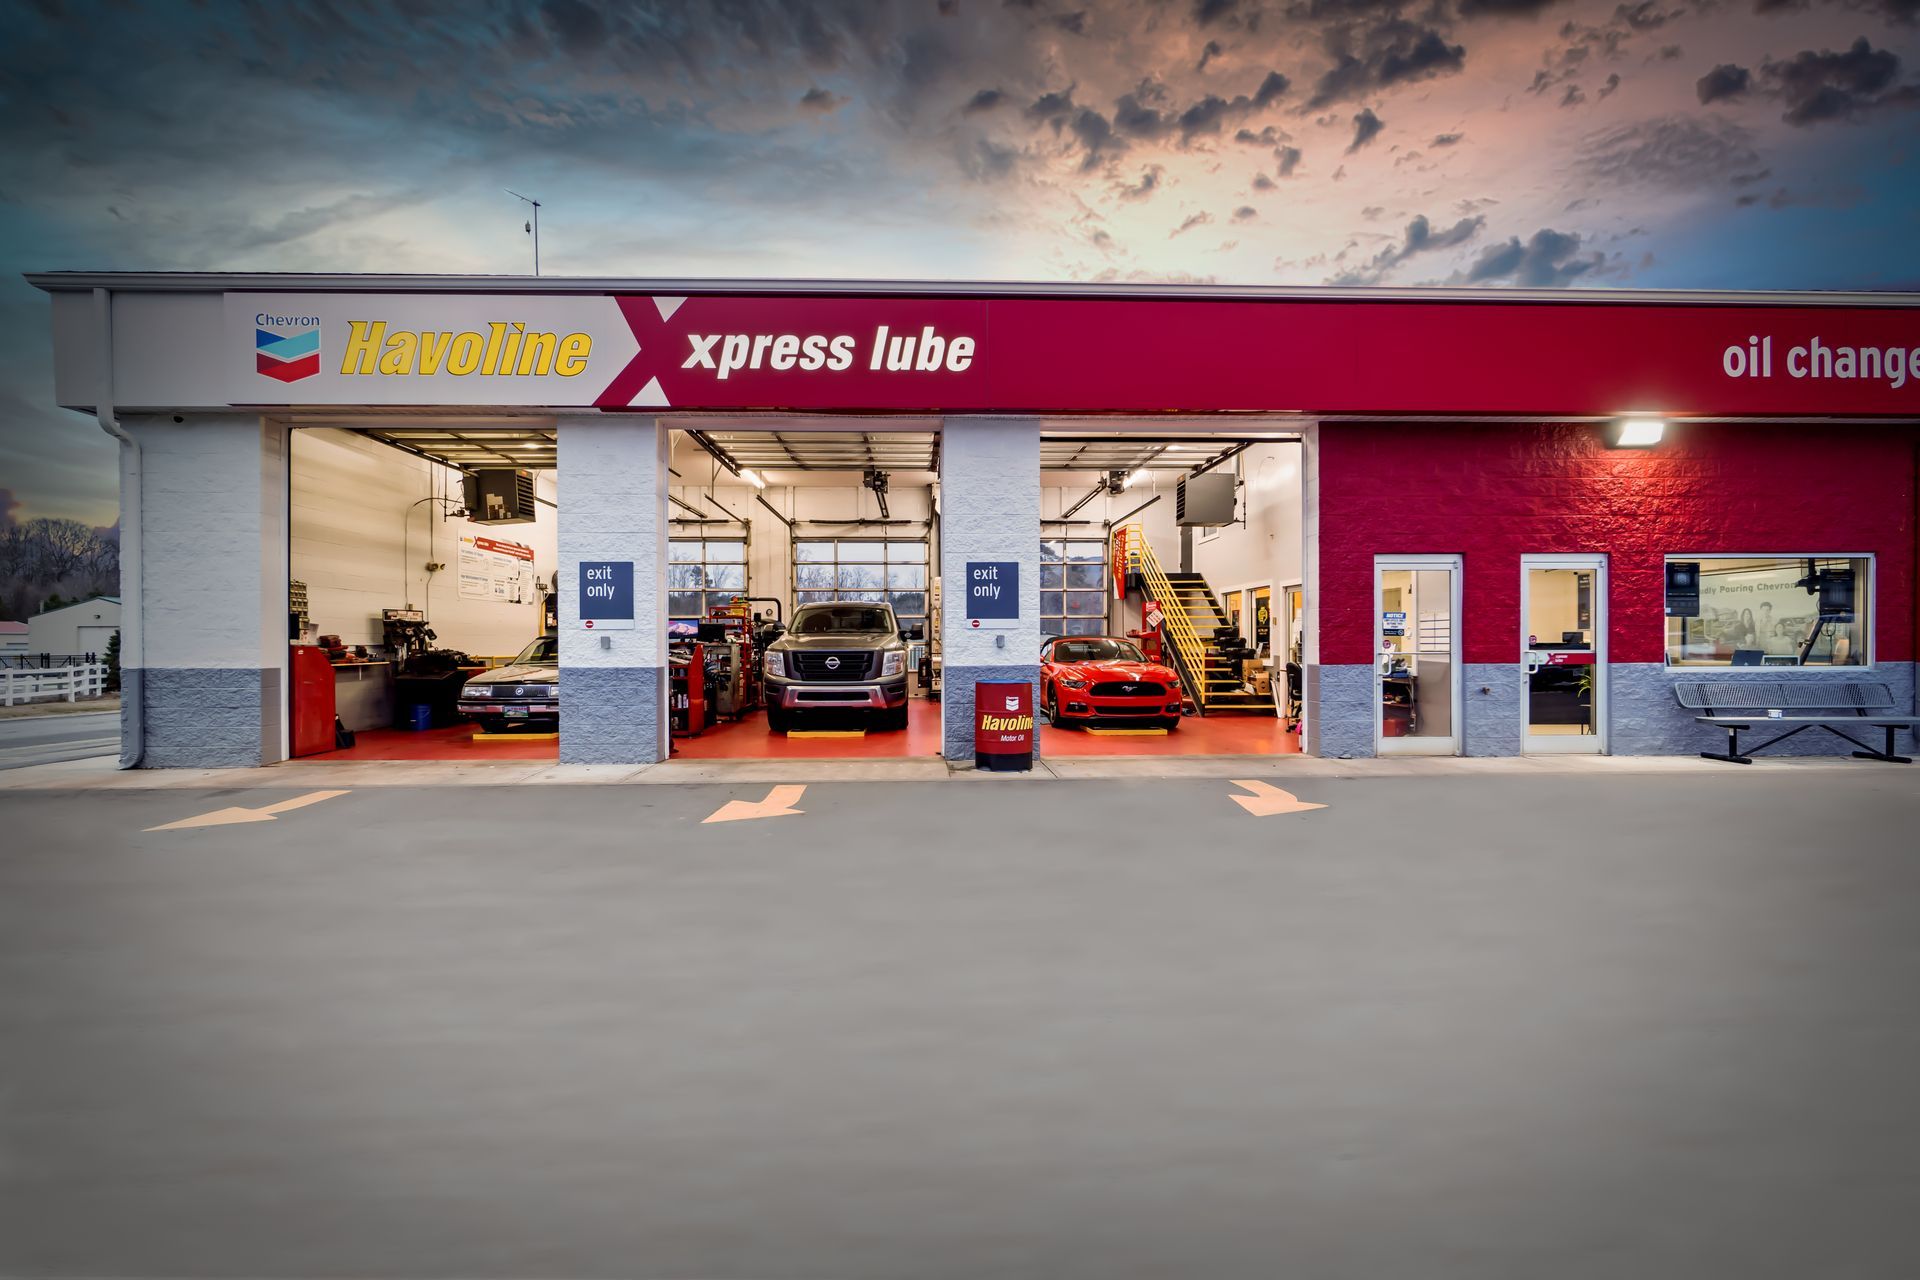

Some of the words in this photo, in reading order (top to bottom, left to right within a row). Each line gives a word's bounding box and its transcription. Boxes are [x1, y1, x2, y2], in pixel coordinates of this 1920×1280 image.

[255, 313, 320, 327] Chevron
[340, 320, 593, 378] Havoline
[681, 333, 856, 380] xpress
[869, 325, 976, 373] lube
[1723, 335, 1772, 378] oil
[587, 565, 612, 580] exit
[973, 565, 998, 580] exit
[587, 583, 615, 600] only
[973, 583, 1001, 600] only
[1719, 585, 1754, 593] Pouring
[1756, 582, 1796, 591] Chevron
[1000, 734, 1017, 742] Motor
[1017, 734, 1025, 742] Oil
